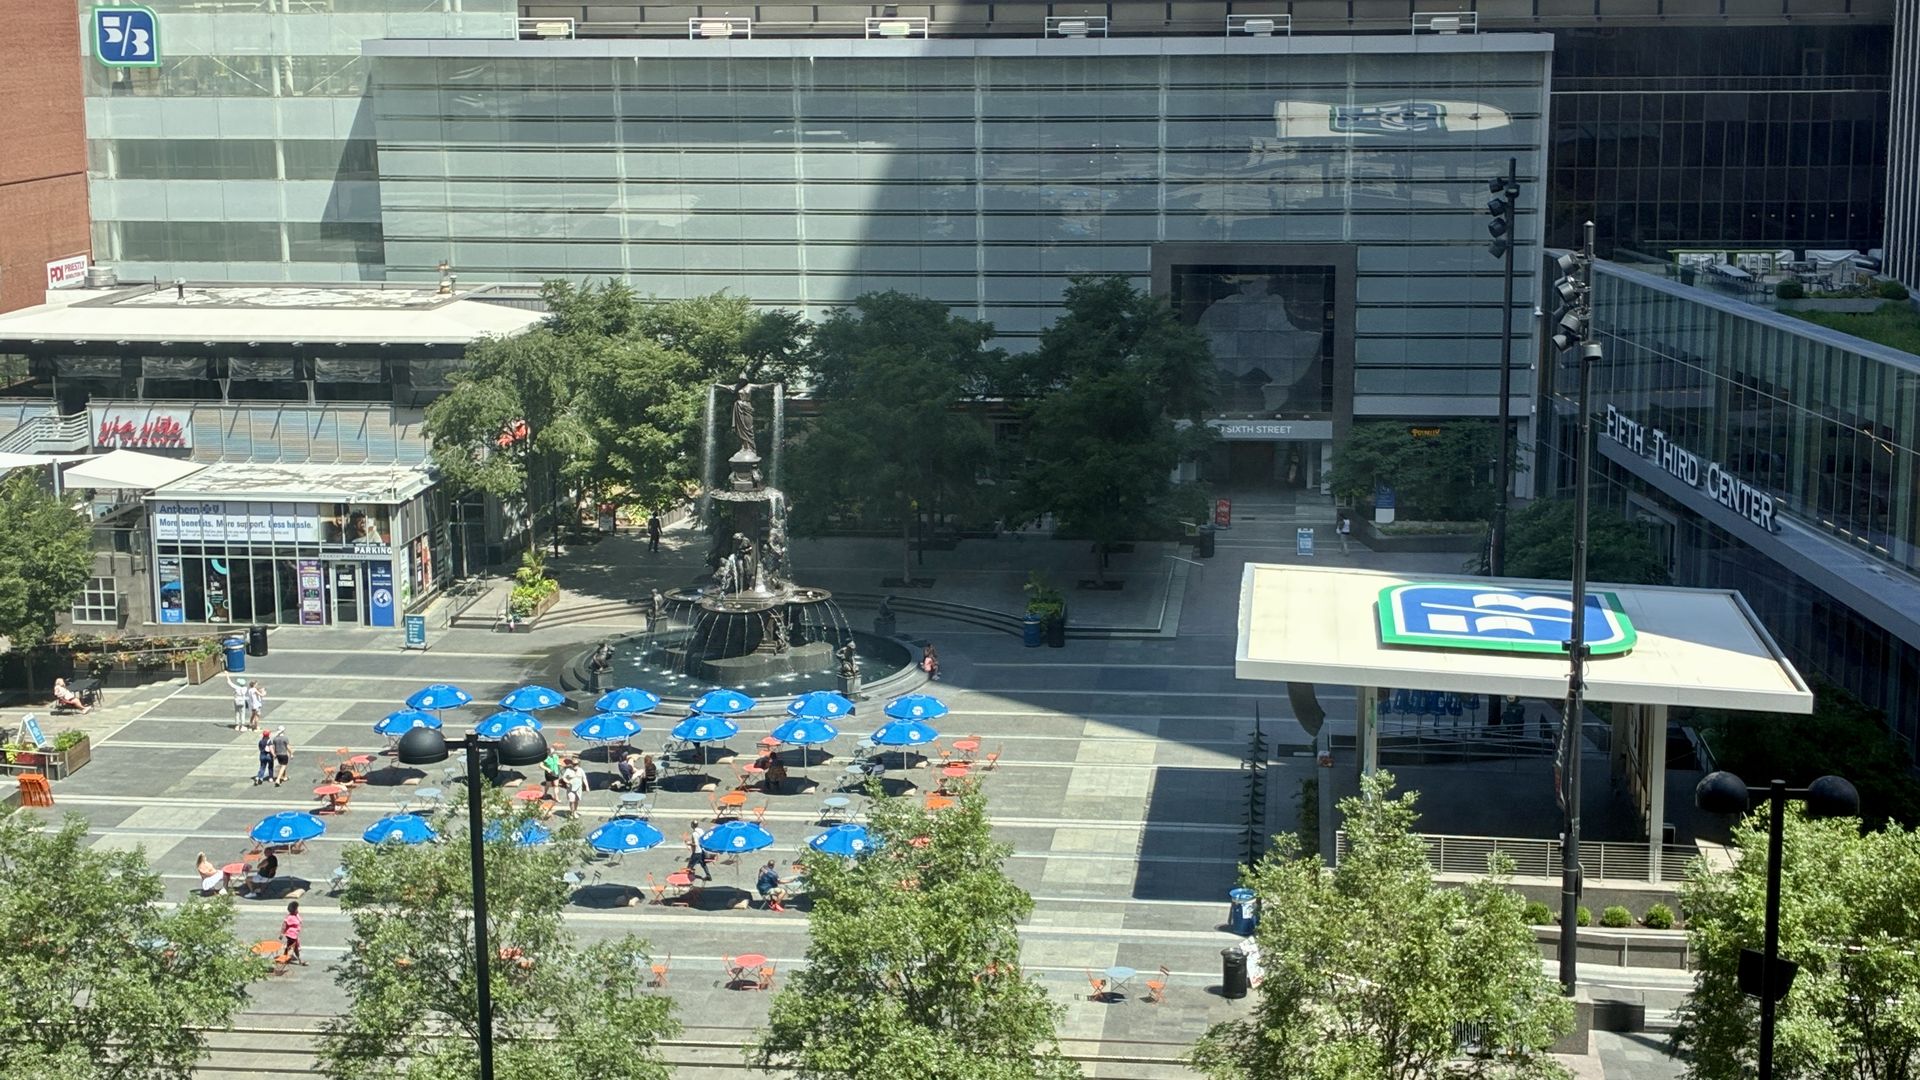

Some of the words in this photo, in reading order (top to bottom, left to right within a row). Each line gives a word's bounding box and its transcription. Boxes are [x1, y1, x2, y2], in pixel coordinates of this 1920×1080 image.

[50, 264, 64, 283] PDI
[64, 260, 85, 273] PRIESTLY
[1226, 425, 1254, 434] SIXTH
[1256, 425, 1292, 434] STREET
[1607, 403, 1645, 456] FIFTH
[1653, 428, 1699, 487] THIRD
[1707, 461, 1773, 533] CENTER
[160, 504, 200, 514] Anthem
[354, 546, 393, 554] PARKING
